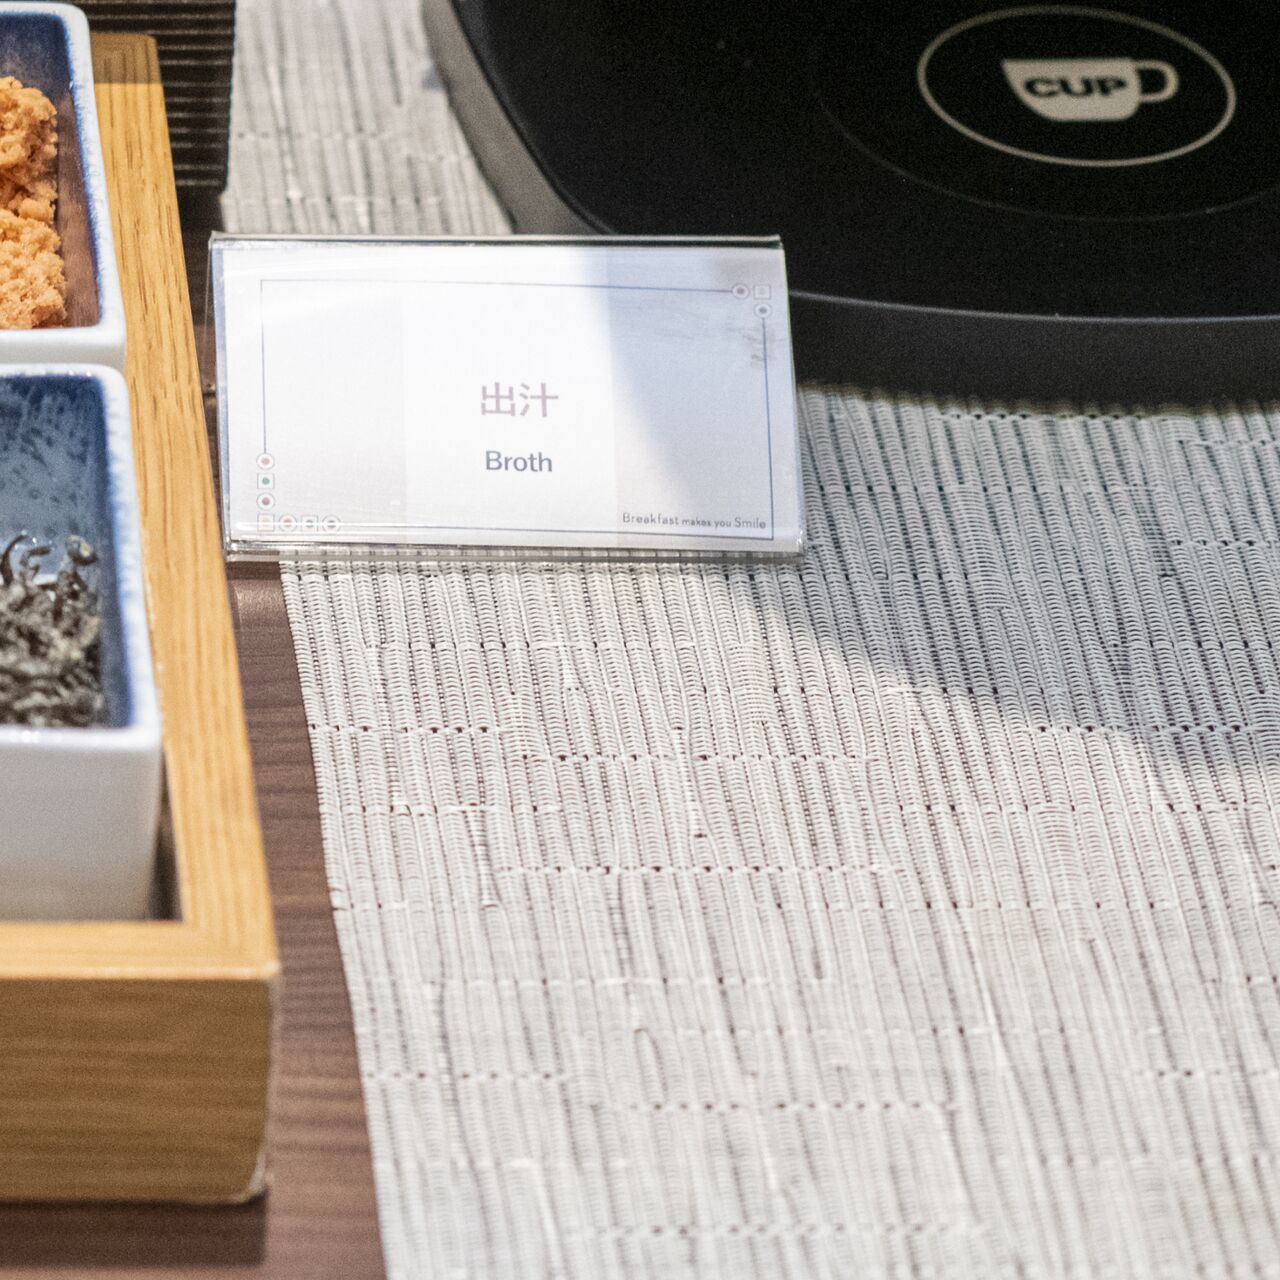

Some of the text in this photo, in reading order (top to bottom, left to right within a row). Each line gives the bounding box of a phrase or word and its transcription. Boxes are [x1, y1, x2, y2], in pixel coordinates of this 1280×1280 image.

[1024, 77, 1127, 98] CUP
[481, 381, 559, 418] 出汁
[485, 450, 553, 472] Broth
[622, 511, 767, 529] Breakfast makes you Smile
